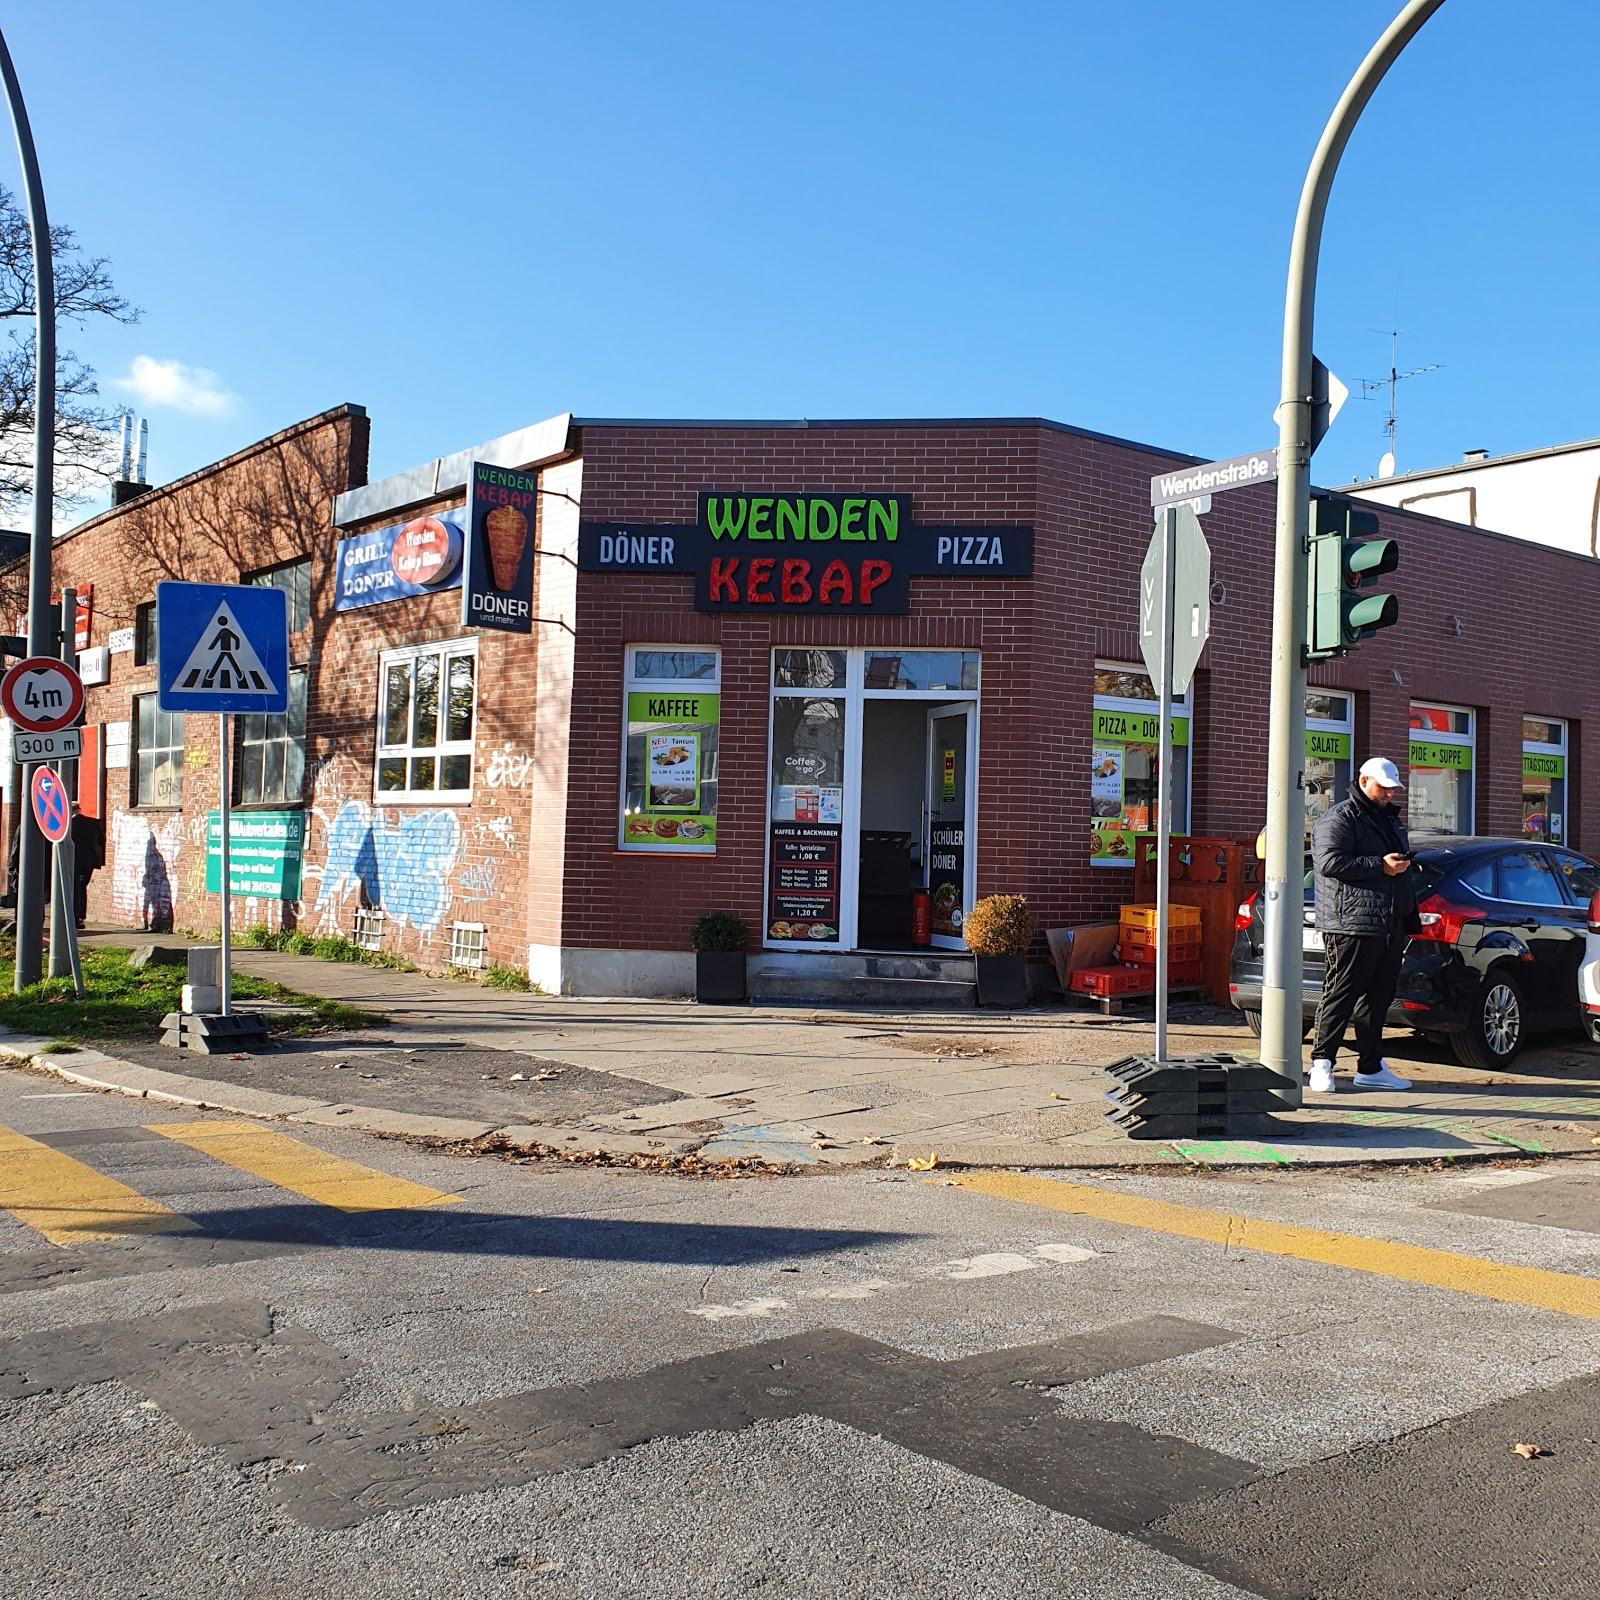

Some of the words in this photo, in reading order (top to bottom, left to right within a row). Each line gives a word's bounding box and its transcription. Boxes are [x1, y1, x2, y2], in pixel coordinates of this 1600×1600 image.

[477, 468, 534, 491] WENDEN
[1160, 457, 1269, 498] Wendenstraße
[476, 484, 533, 508] KEBAP
[707, 498, 898, 541] WENDEN
[405, 529, 436, 547] Wenden
[599, 530, 675, 565] DÖNER
[344, 542, 388, 568] GRILL
[937, 536, 1004, 565] PIZZA
[343, 570, 395, 596] DÖNER
[709, 557, 893, 606] KEBAP
[471, 591, 529, 618] DÖNER
[480, 614, 495, 622] und
[24, 681, 63, 709] 4m
[648, 699, 699, 718] KAFFEE
[1098, 716, 1127, 736] PIZZA
[20, 738, 55, 754] 300
[63, 740, 75, 751] m
[1311, 736, 1340, 754] SALATE
[1411, 745, 1427, 761] PIDE
[1439, 748, 1462, 765] SUPPE
[785, 757, 816, 766] Coffee
[803, 829, 838, 837] BACKWAREN
[933, 827, 964, 846] SCHÜLER
[932, 851, 957, 870] DÖNER
